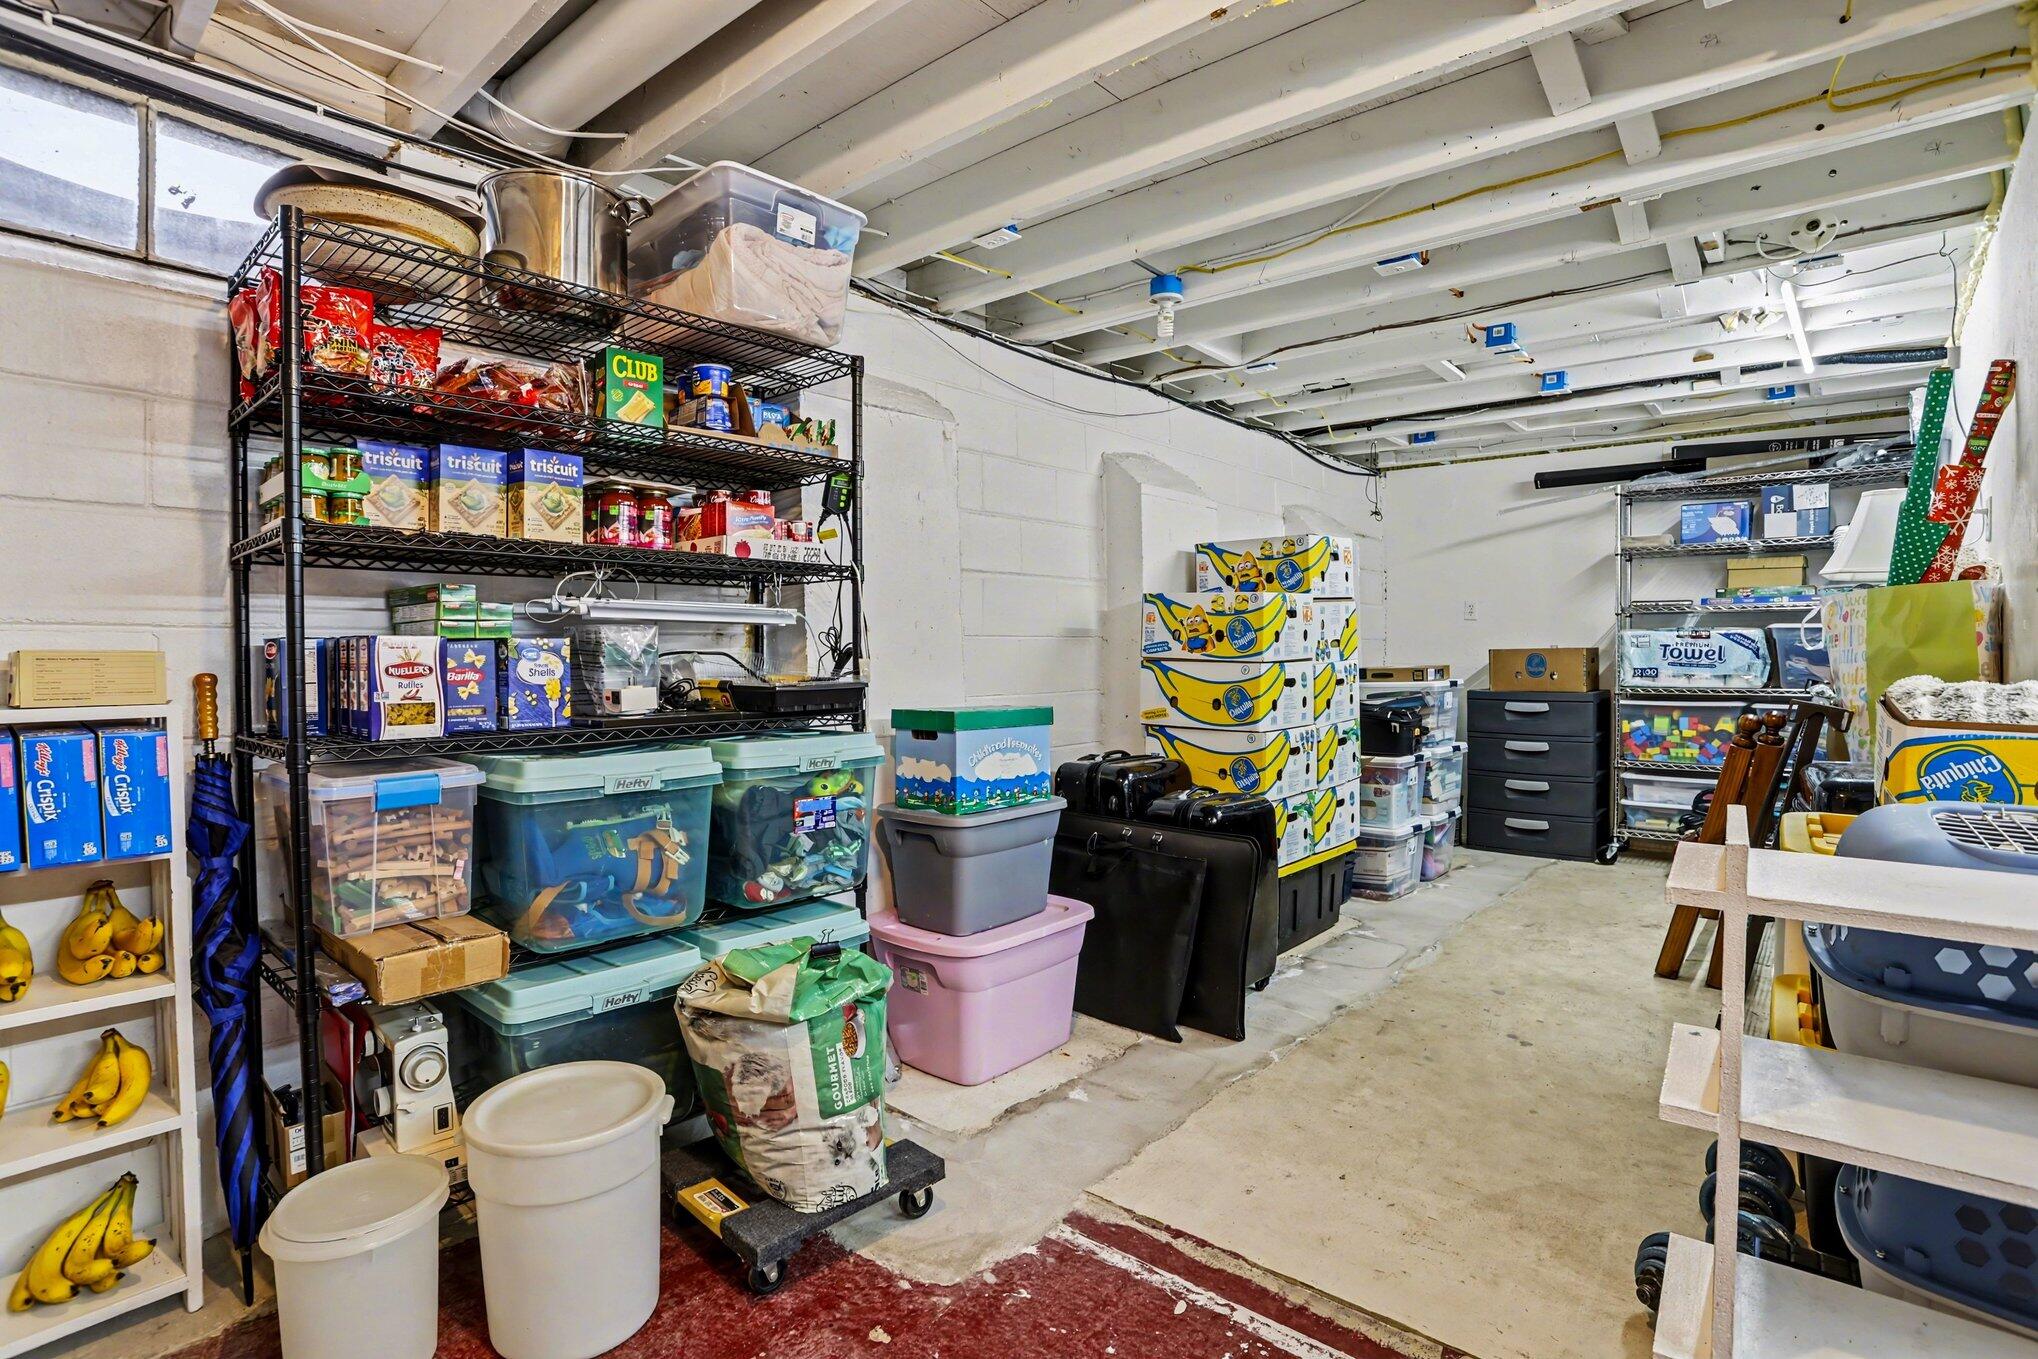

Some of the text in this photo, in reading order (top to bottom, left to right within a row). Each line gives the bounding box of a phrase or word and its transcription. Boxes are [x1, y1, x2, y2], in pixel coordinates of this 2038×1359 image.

[612, 355, 658, 382] CLUB
[365, 450, 423, 471] triscuit
[447, 455, 502, 474] triscuit
[530, 458, 578, 477] triscuit
[1232, 631, 1256, 648] Chiquita
[1660, 643, 1725, 662] Towel
[447, 670, 480, 681] Barilla
[529, 668, 556, 677] Shells
[35, 742, 50, 777] Kellogg's
[113, 738, 128, 772] Kellogg's
[968, 738, 1007, 767] Childhood
[807, 757, 835, 770] Hefty
[1919, 754, 2002, 792] Chiquita
[615, 776, 652, 790] Hefty
[36, 779, 59, 822] Crispix
[114, 774, 131, 814] Crispix
[605, 993, 639, 1008] Hefty
[826, 1047, 843, 1110] GOURMET
